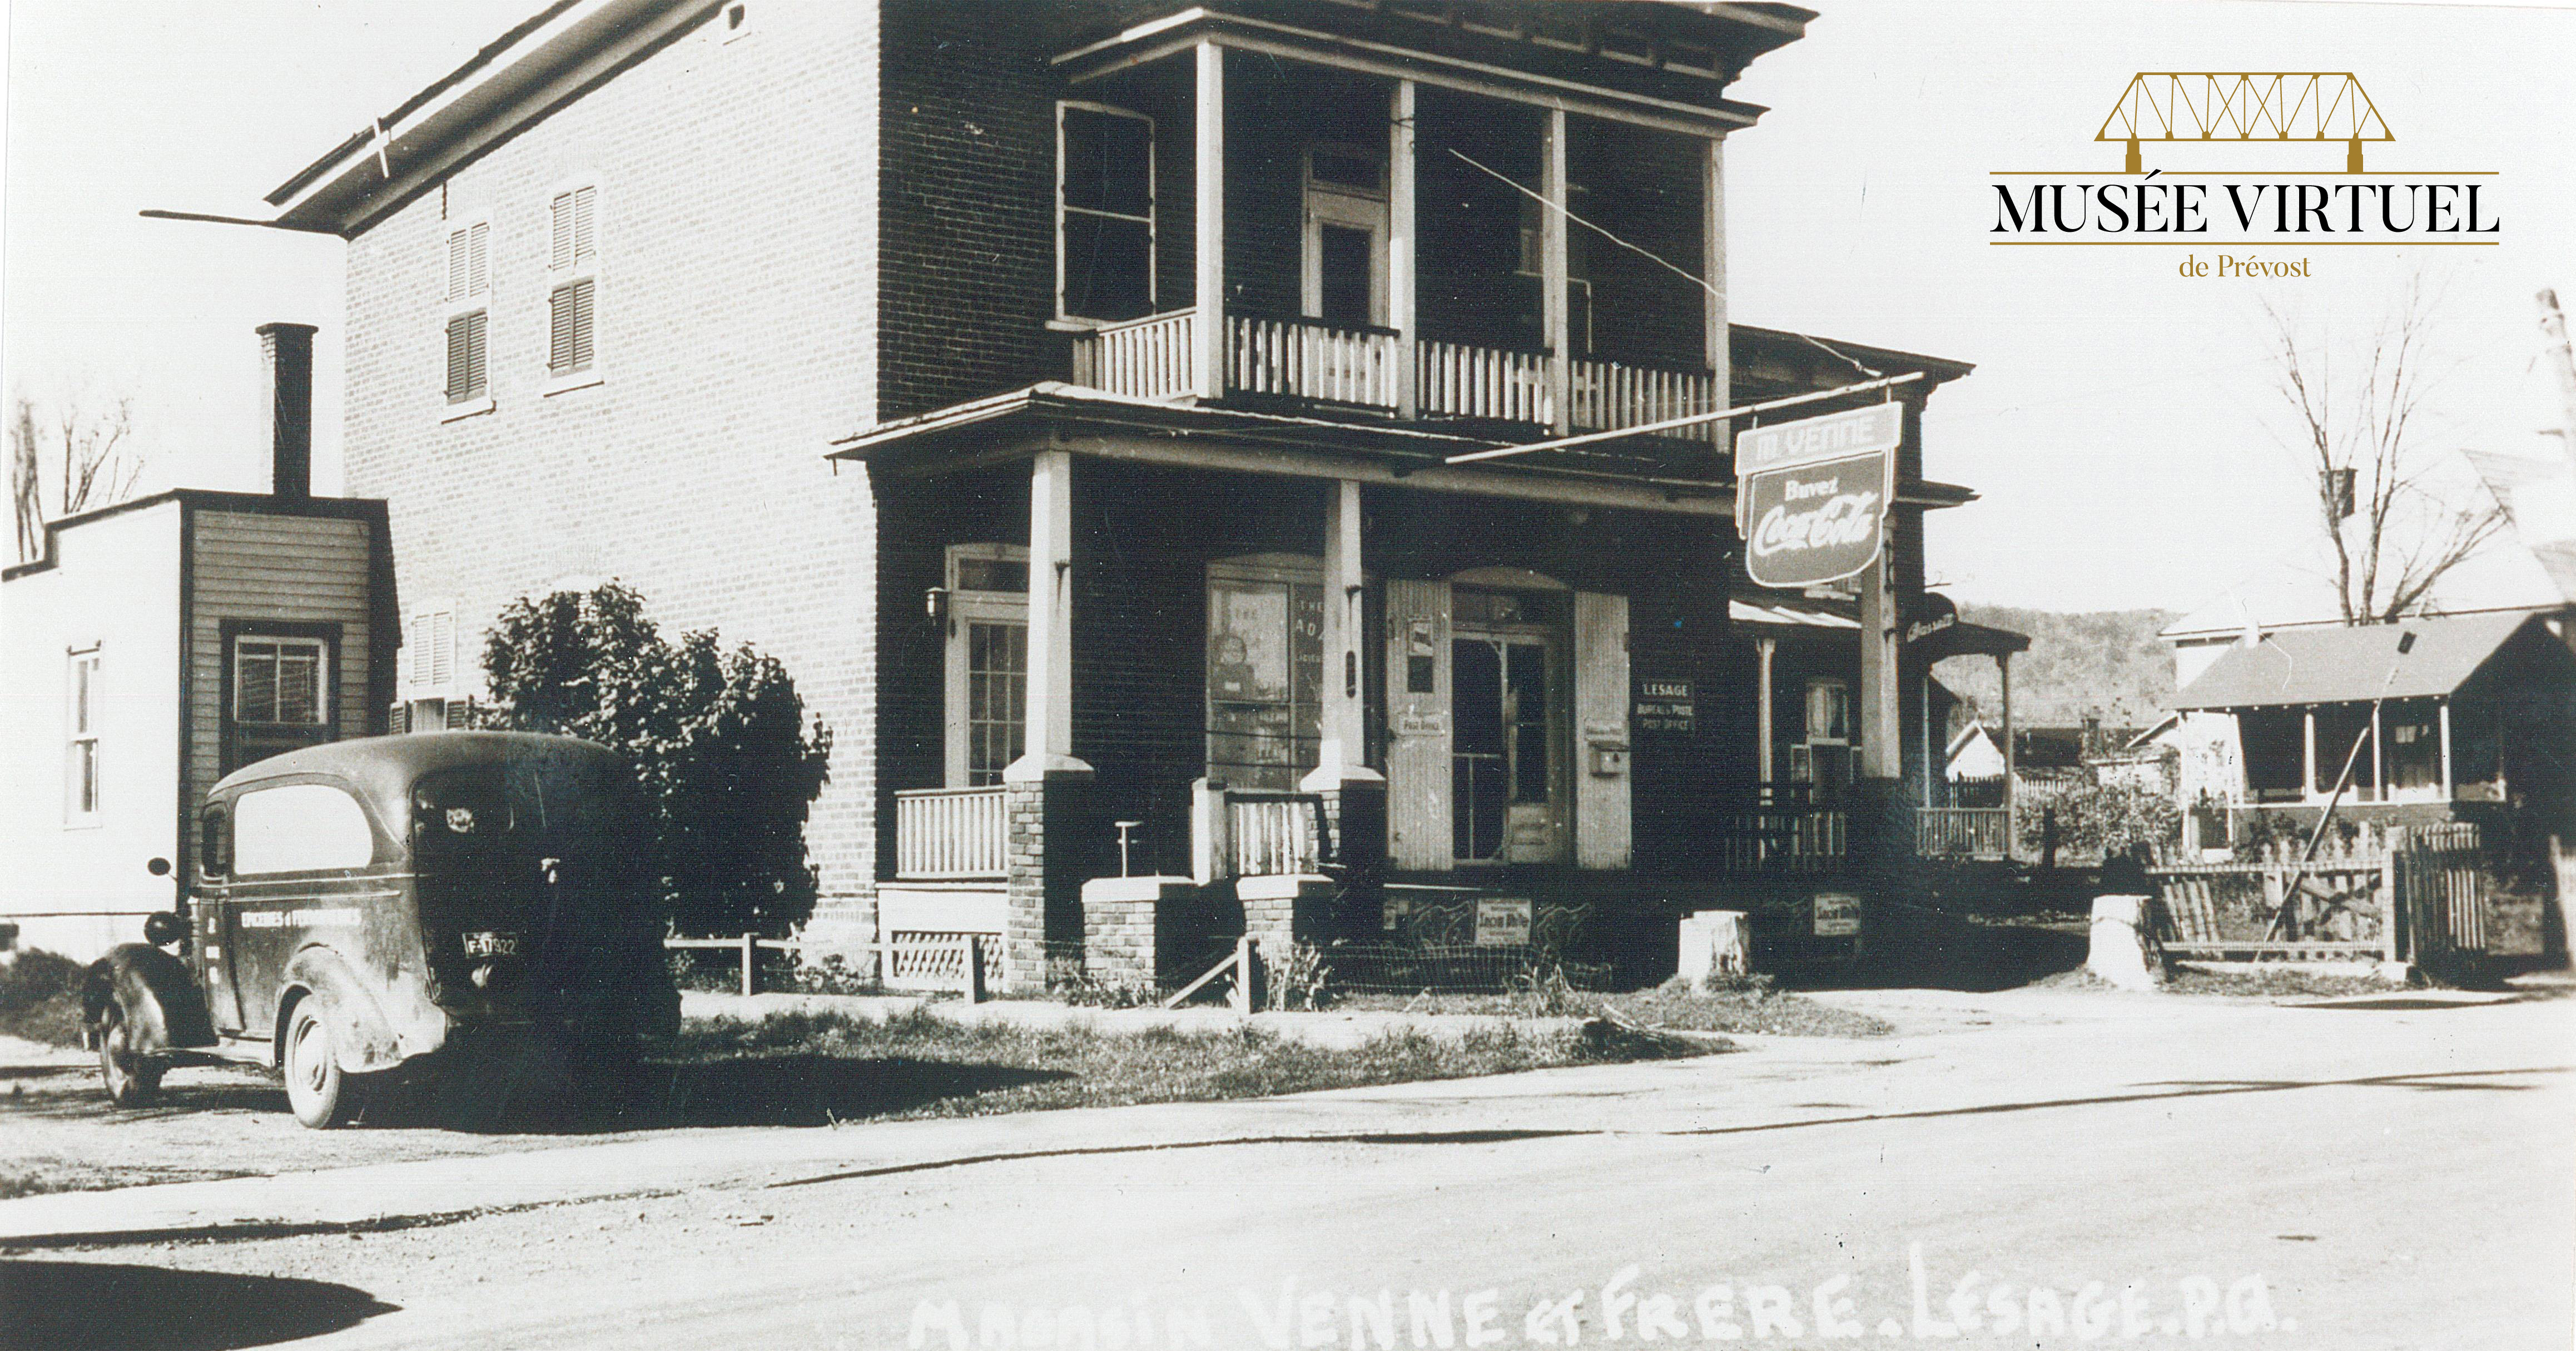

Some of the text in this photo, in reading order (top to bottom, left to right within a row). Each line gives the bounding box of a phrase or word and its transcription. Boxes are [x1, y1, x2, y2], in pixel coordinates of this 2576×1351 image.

[1786, 416, 1876, 453] VENNE
[1785, 476, 1838, 501] Buvez
[1642, 683, 1688, 697] LESAGE
[468, 938, 517, 956] F-17922
